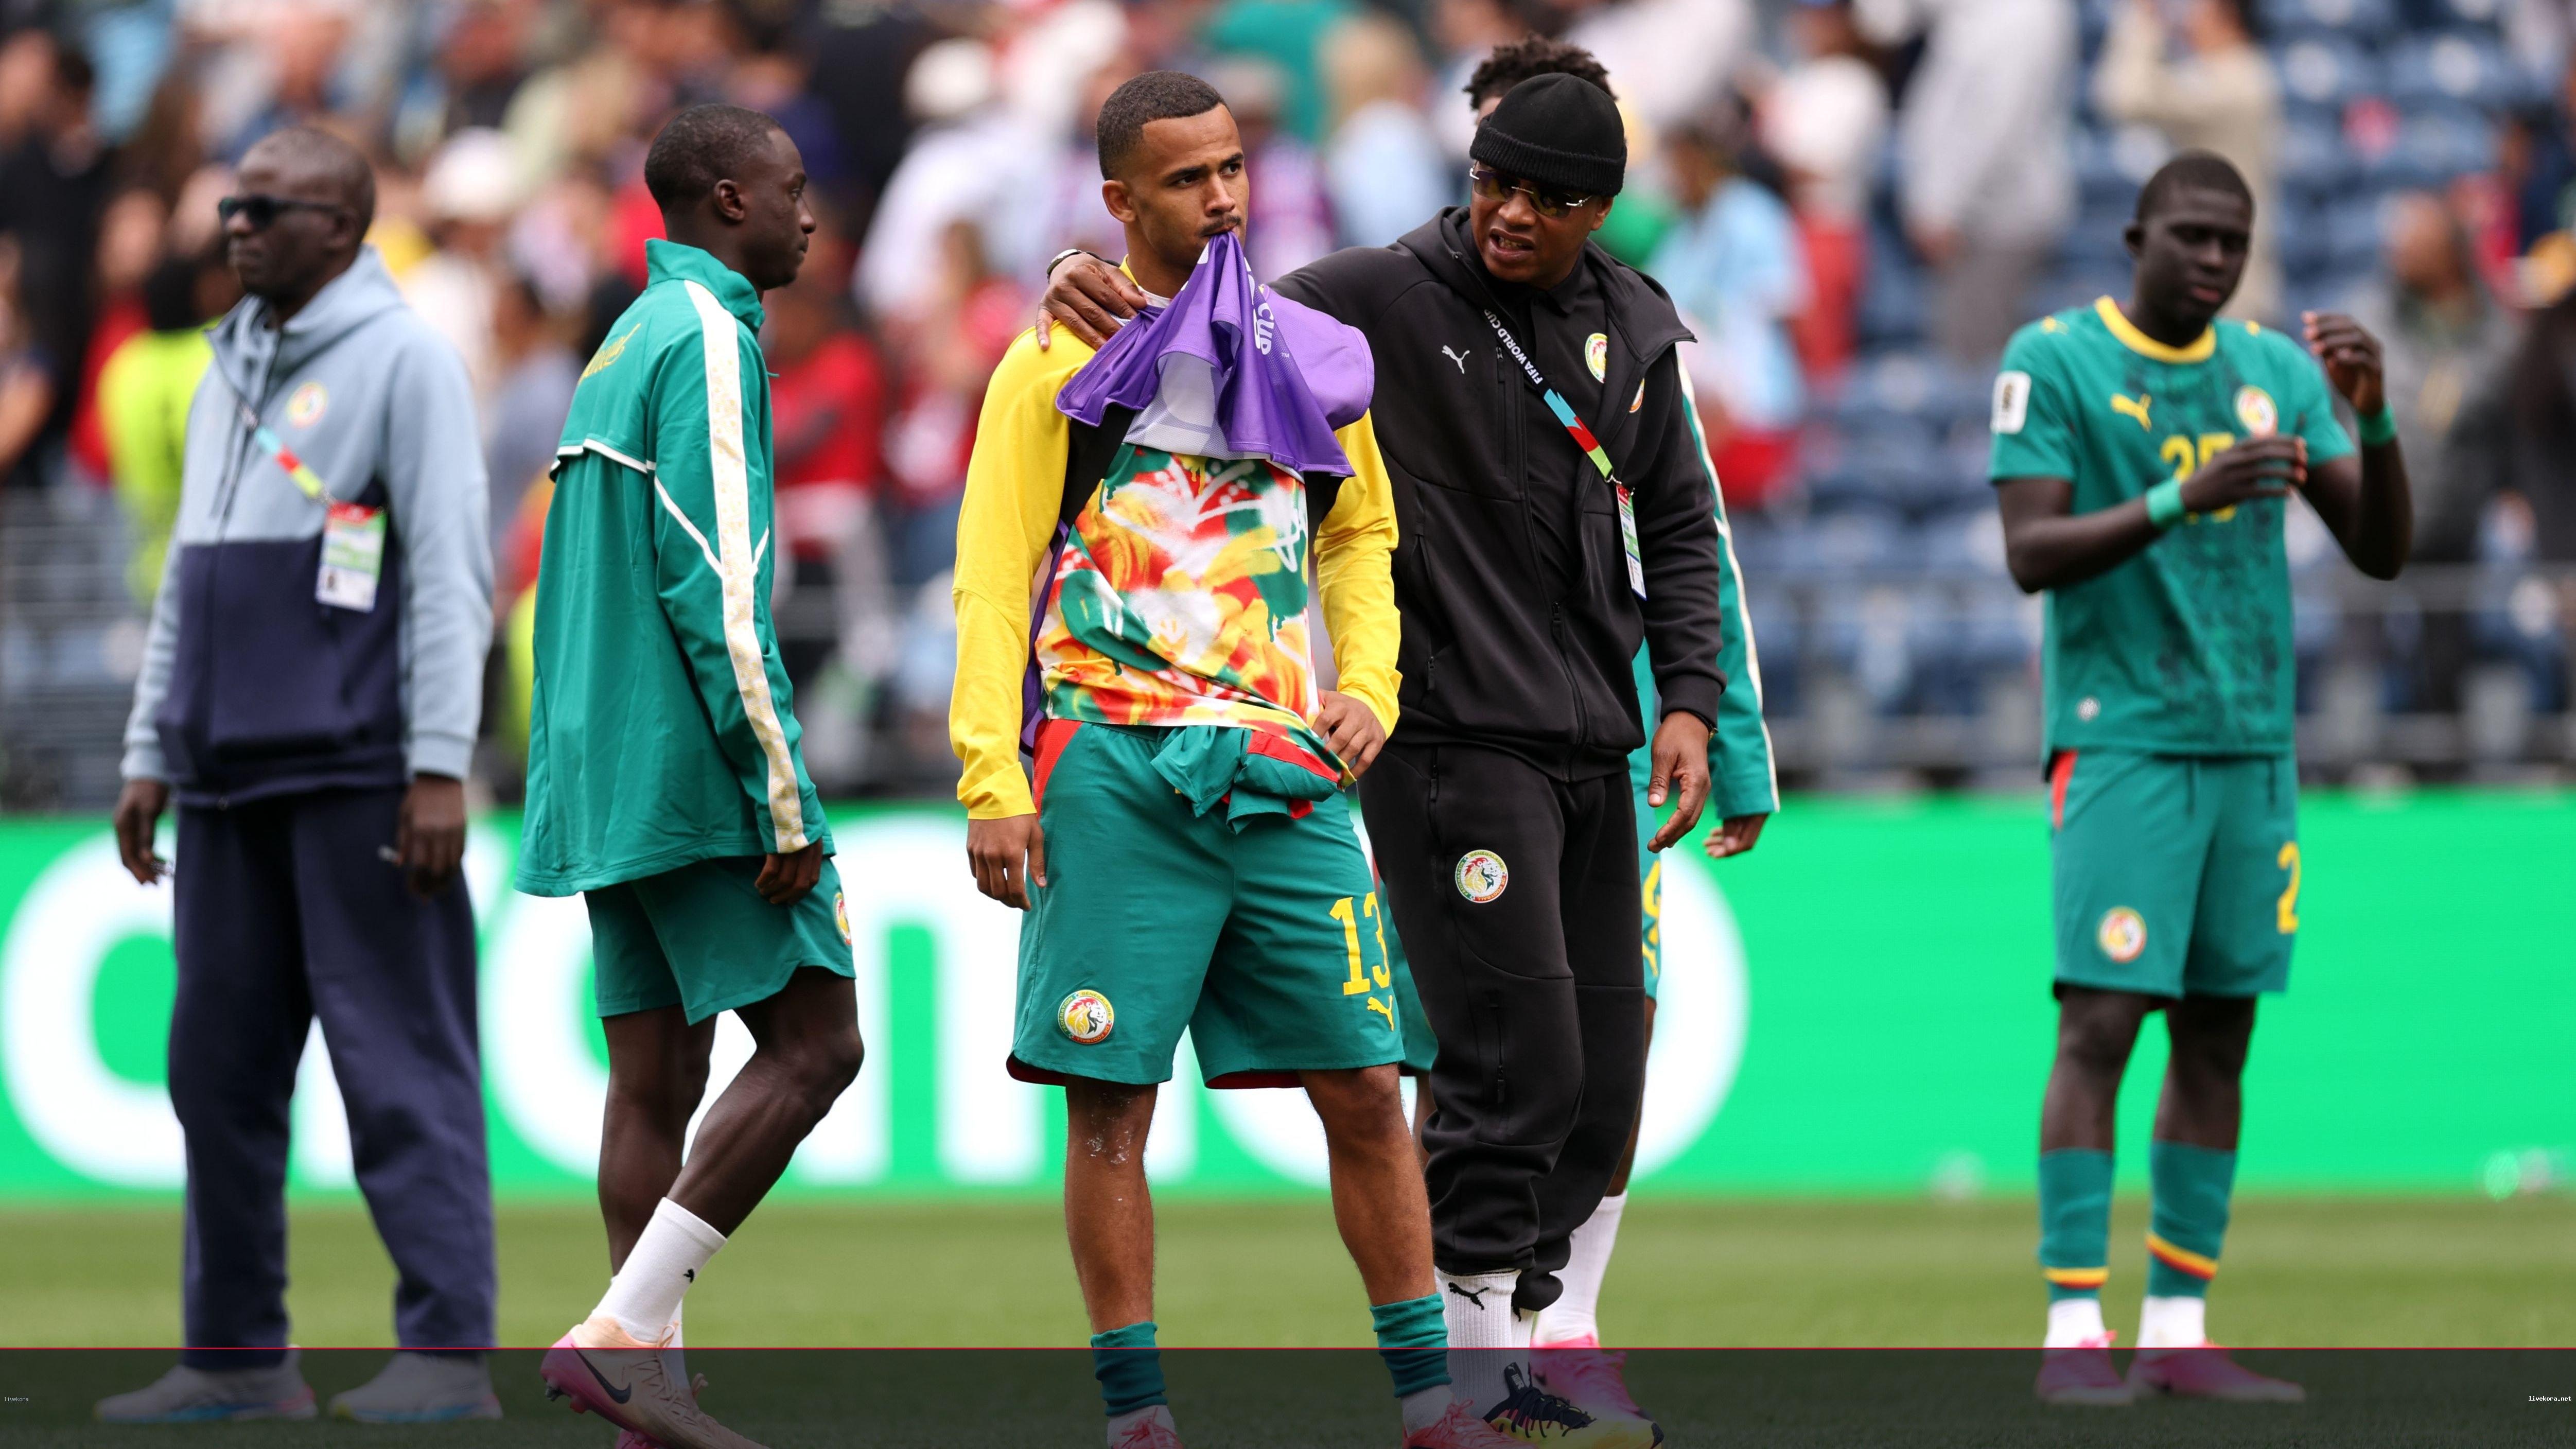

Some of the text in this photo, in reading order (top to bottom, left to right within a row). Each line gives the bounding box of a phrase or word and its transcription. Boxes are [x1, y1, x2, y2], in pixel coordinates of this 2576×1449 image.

[1258, 303, 1274, 355] CUP
[1484, 309, 1543, 385] FIFA WORLD CUP
[1329, 891, 1390, 996] 13
